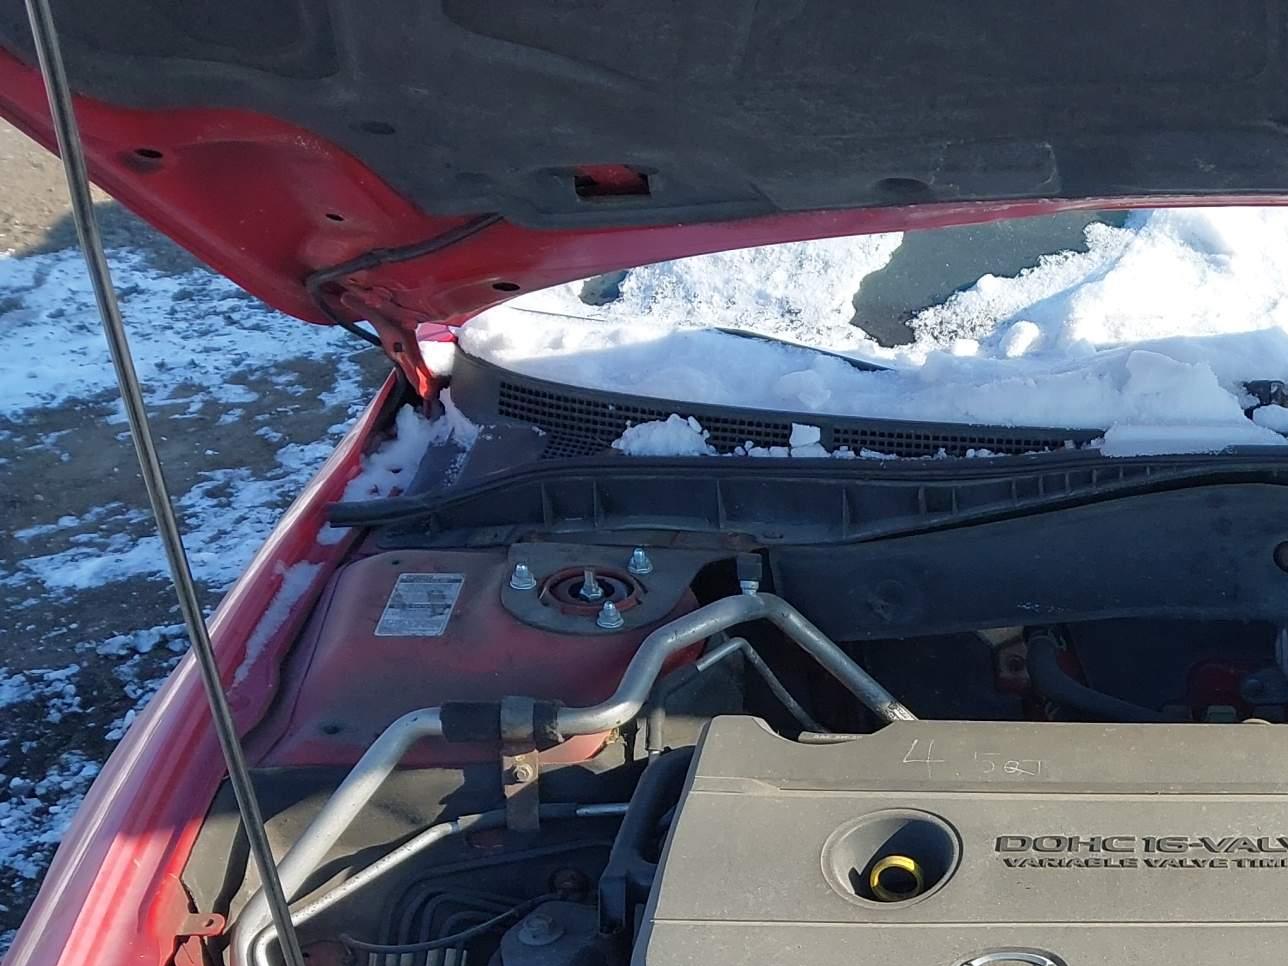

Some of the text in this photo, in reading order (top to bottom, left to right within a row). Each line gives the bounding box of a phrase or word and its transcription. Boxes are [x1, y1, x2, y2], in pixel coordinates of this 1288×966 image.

[995, 835, 1138, 853] DOHC
[1003, 857, 1139, 868] VARIABLE
[1144, 857, 1230, 868] VALVE
